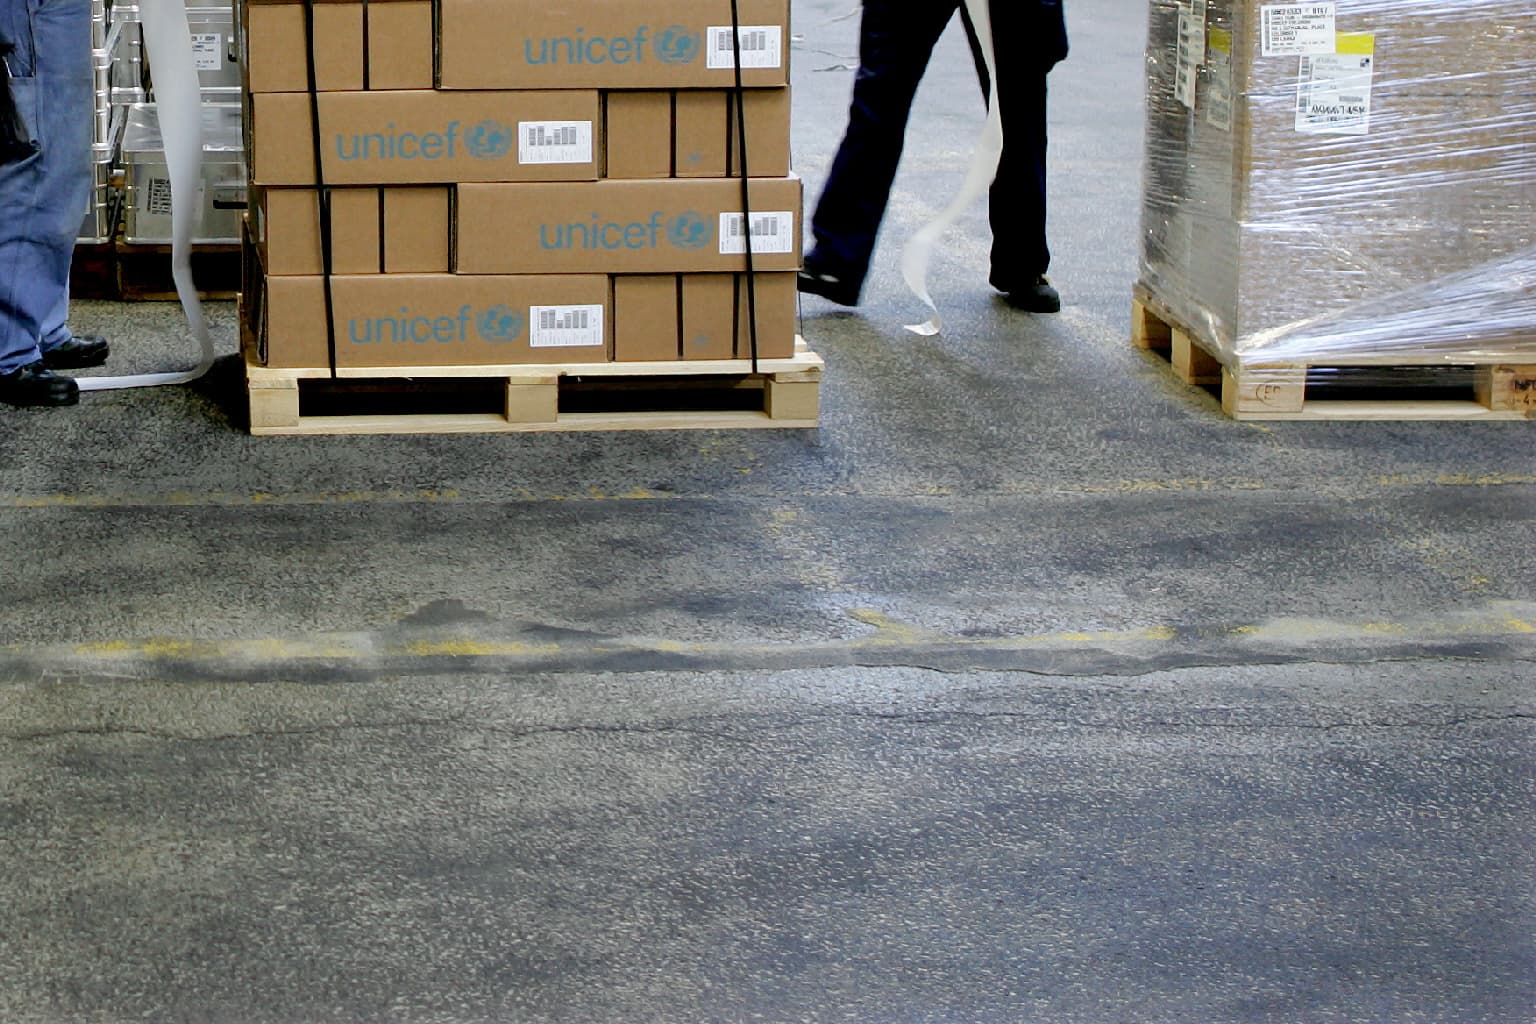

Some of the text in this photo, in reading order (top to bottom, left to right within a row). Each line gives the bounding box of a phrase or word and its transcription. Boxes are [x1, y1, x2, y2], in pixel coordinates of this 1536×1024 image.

[524, 25, 649, 65] unicef
[335, 120, 460, 161] unicef
[539, 211, 663, 251] unicef
[348, 305, 473, 345] unicef
